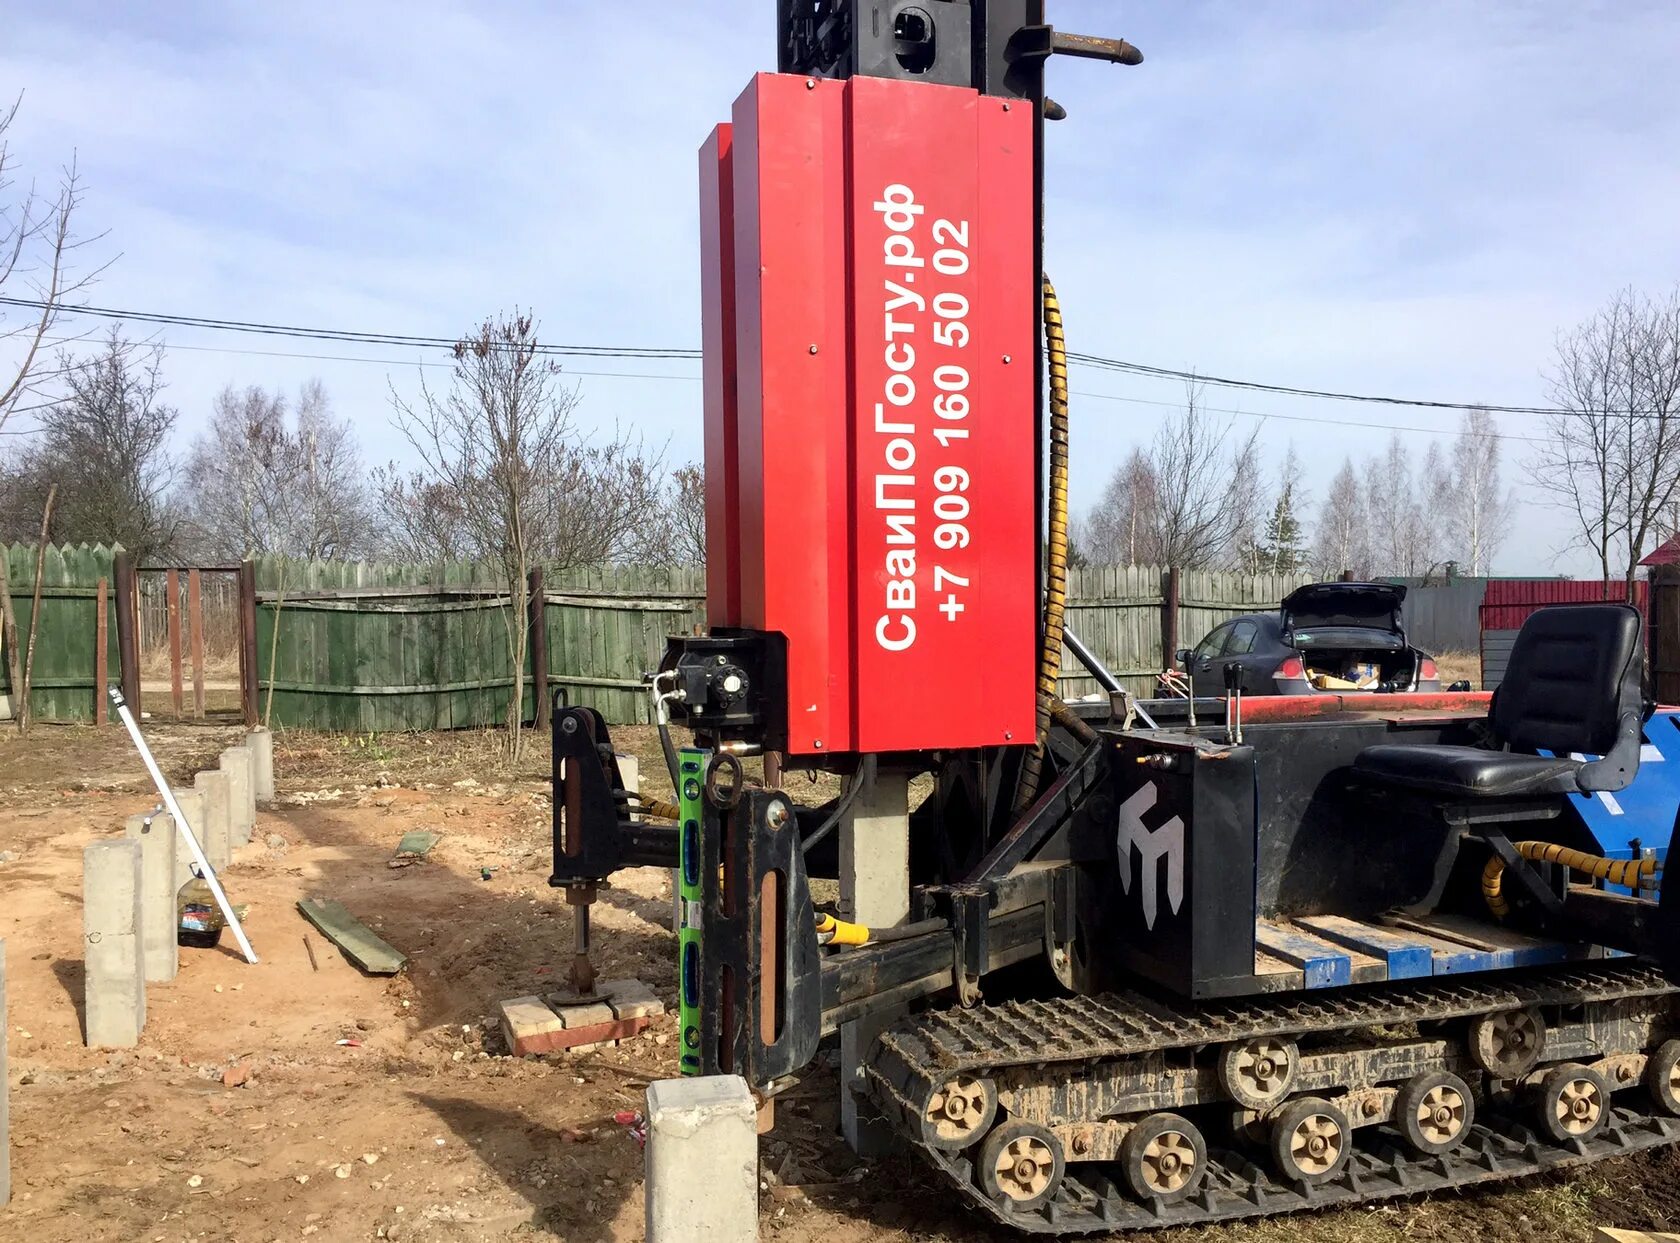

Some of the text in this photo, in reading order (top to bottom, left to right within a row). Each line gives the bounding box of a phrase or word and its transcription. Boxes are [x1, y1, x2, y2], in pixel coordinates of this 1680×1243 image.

[874, 183, 926, 651] СваиПоГосту.рф
[931, 218, 970, 622] +7 909 160 50 02
